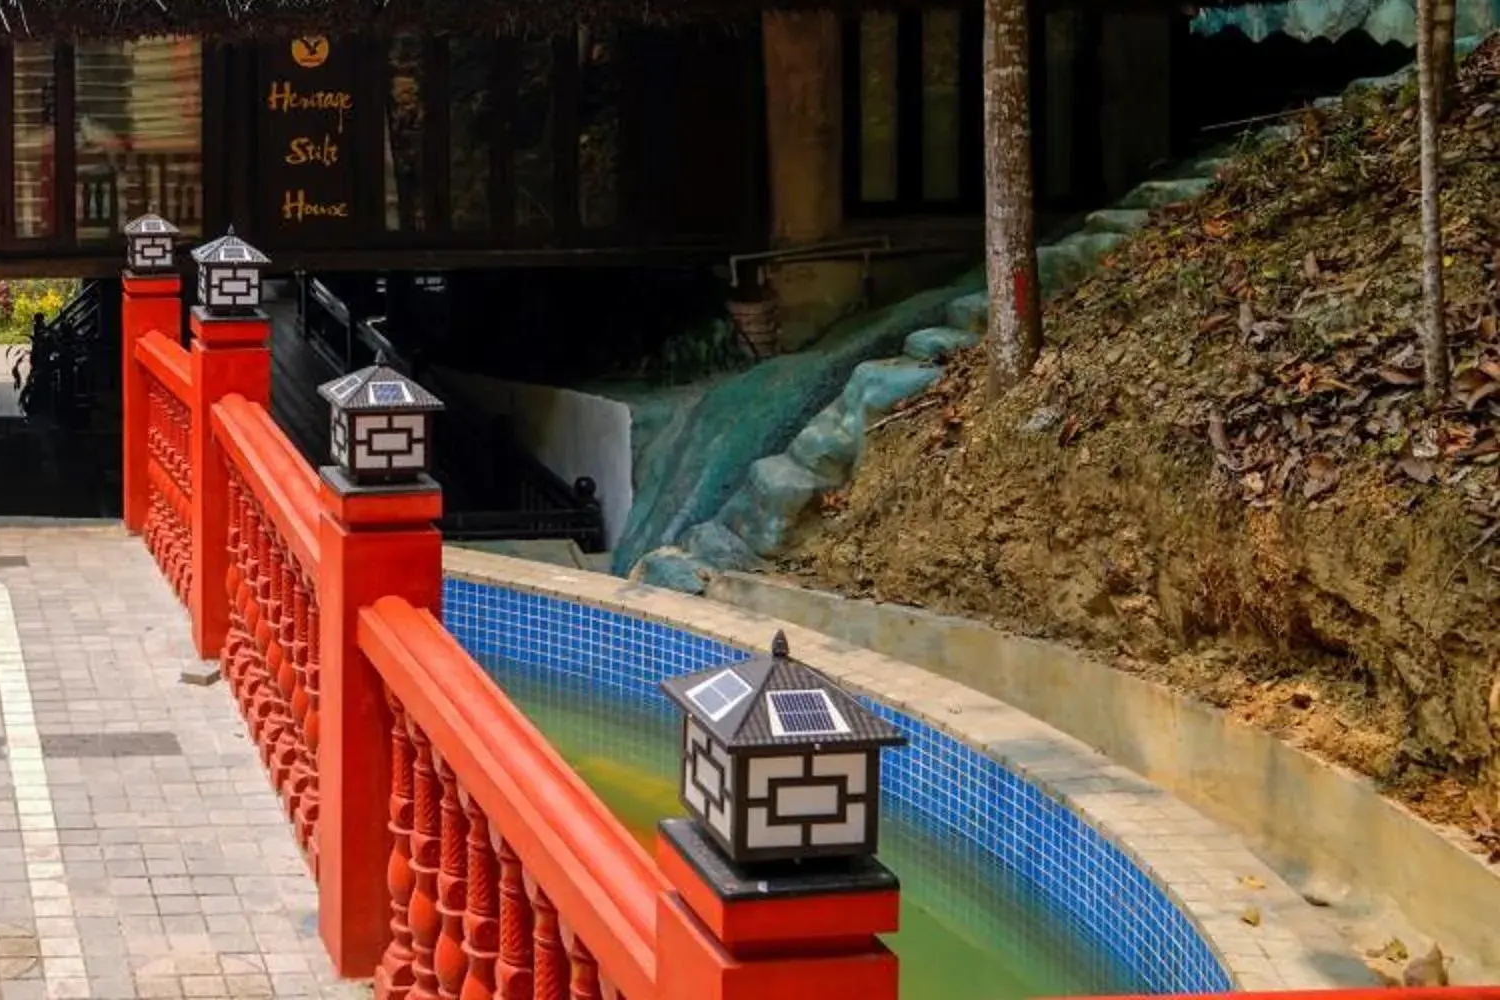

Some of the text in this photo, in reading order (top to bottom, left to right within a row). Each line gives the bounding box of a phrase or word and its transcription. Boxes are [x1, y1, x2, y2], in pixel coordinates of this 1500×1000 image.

[268, 80, 353, 133] Heritage
[285, 134, 338, 166] Stilt
[282, 189, 349, 223] House
